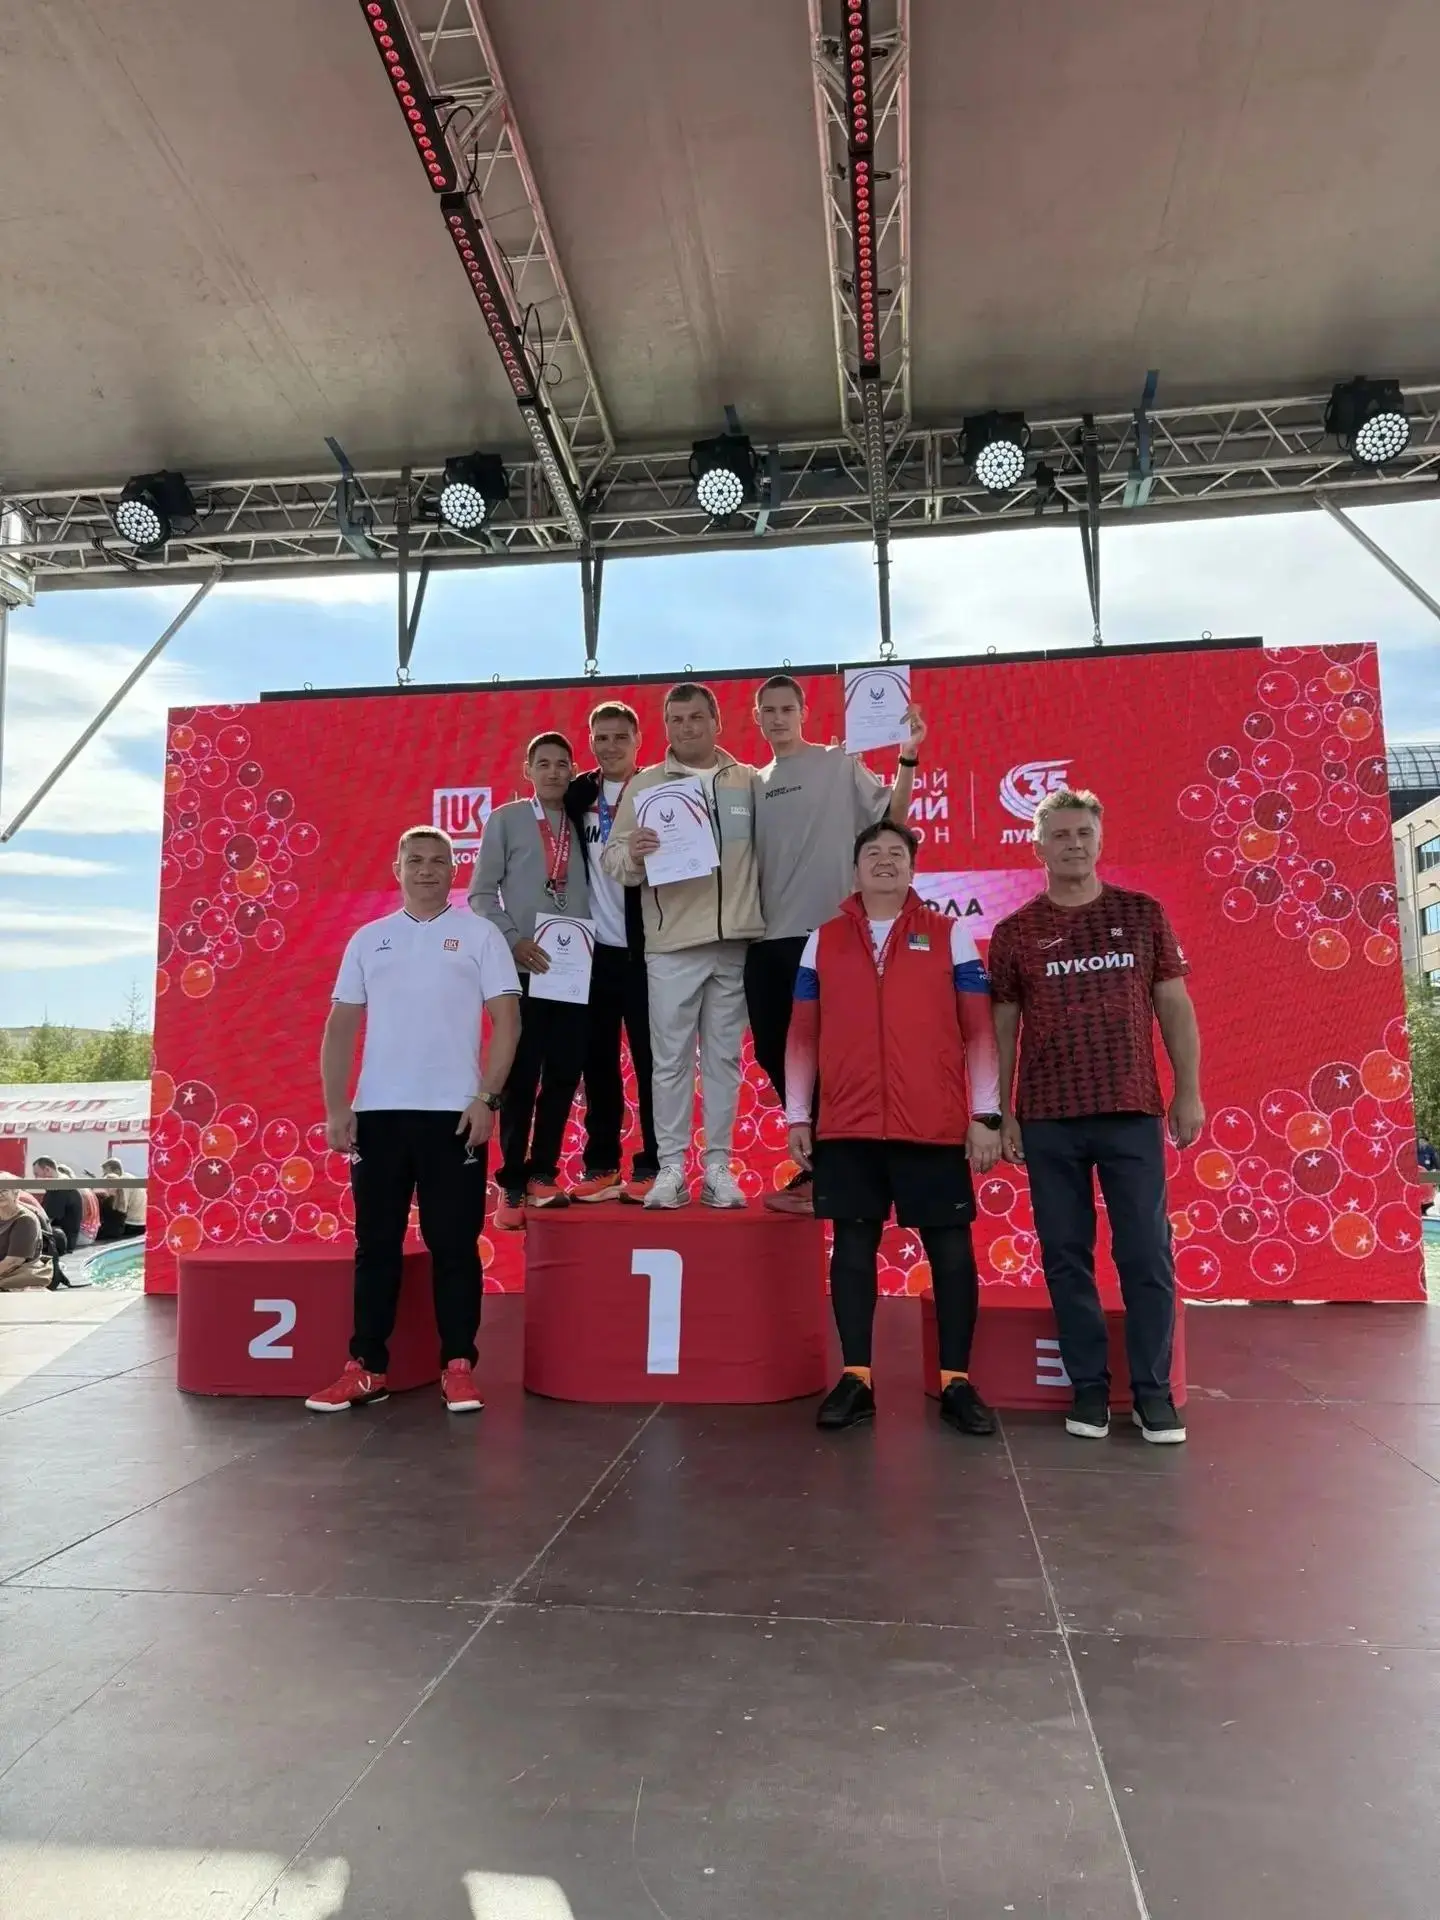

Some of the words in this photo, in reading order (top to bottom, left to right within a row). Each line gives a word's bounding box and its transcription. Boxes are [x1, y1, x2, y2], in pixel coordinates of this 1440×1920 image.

[1023, 769, 1069, 804] 35
[1045, 950, 1135, 977] ЛУКОЙЛ
[247, 1298, 298, 1360] 2
[630, 1248, 684, 1375] 1
